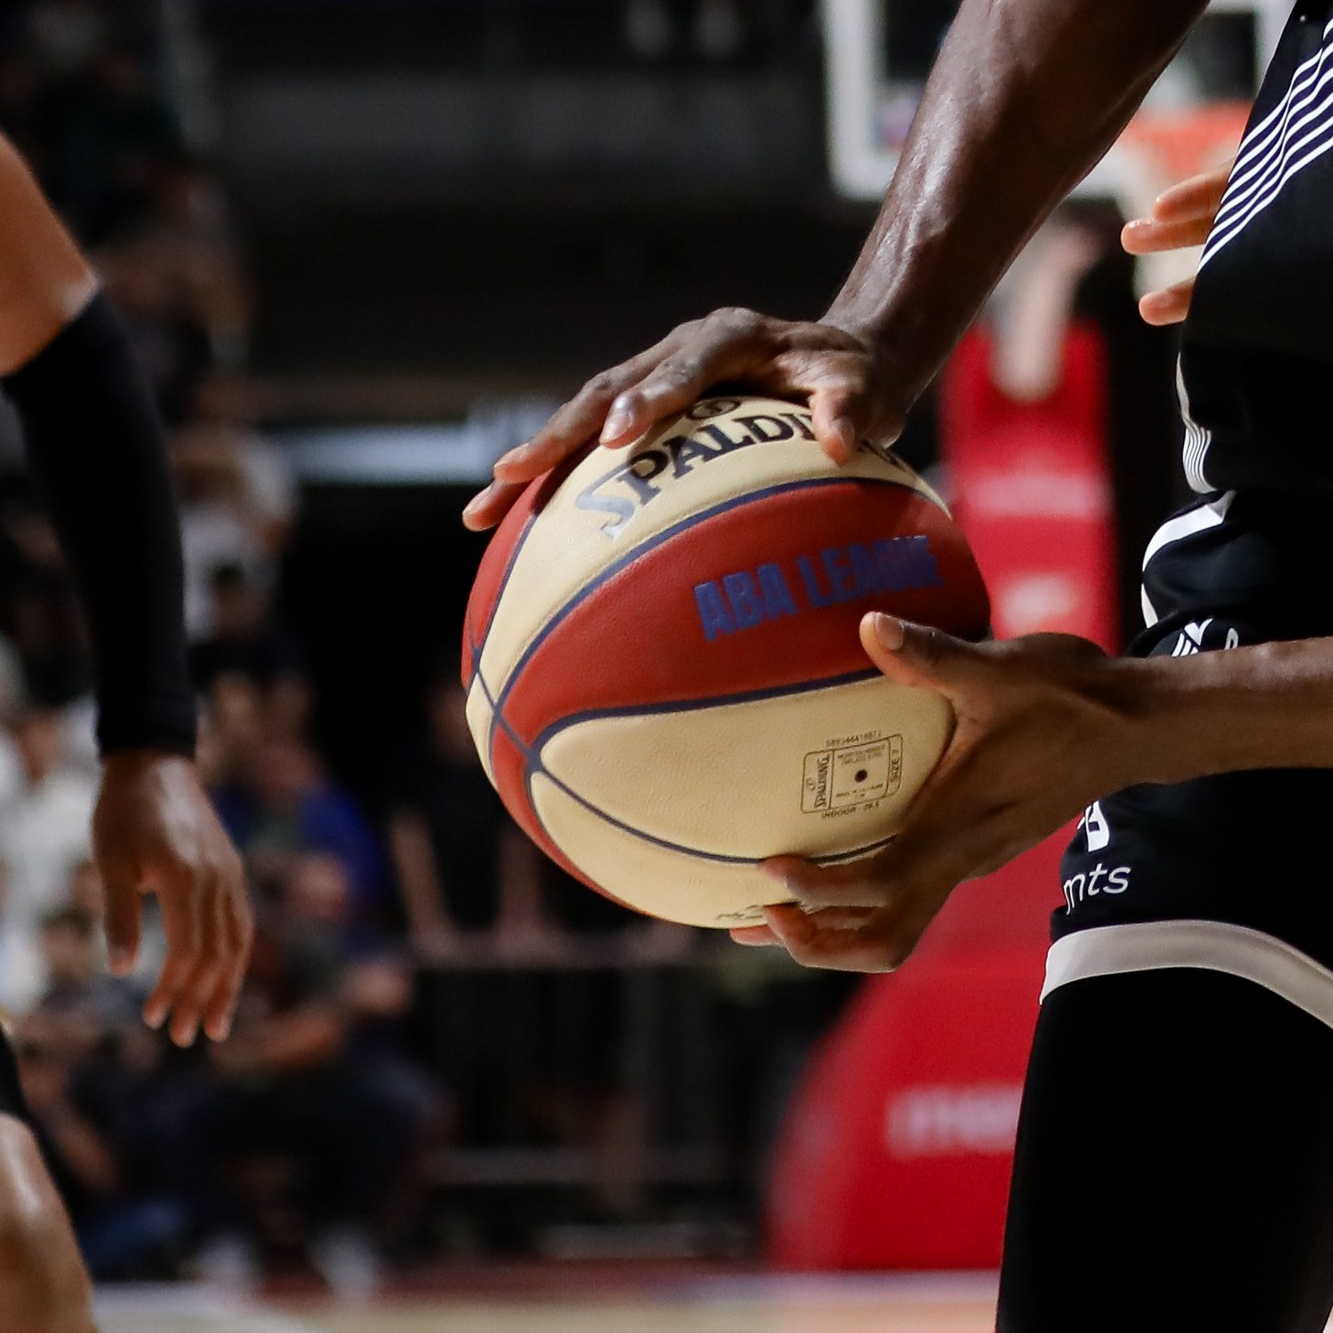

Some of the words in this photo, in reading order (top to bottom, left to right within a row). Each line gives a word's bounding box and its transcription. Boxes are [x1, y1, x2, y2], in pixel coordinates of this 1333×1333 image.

[575, 412, 908, 541] SPALDI
[694, 562, 798, 643] ABA
[1063, 863, 1132, 916] mts
